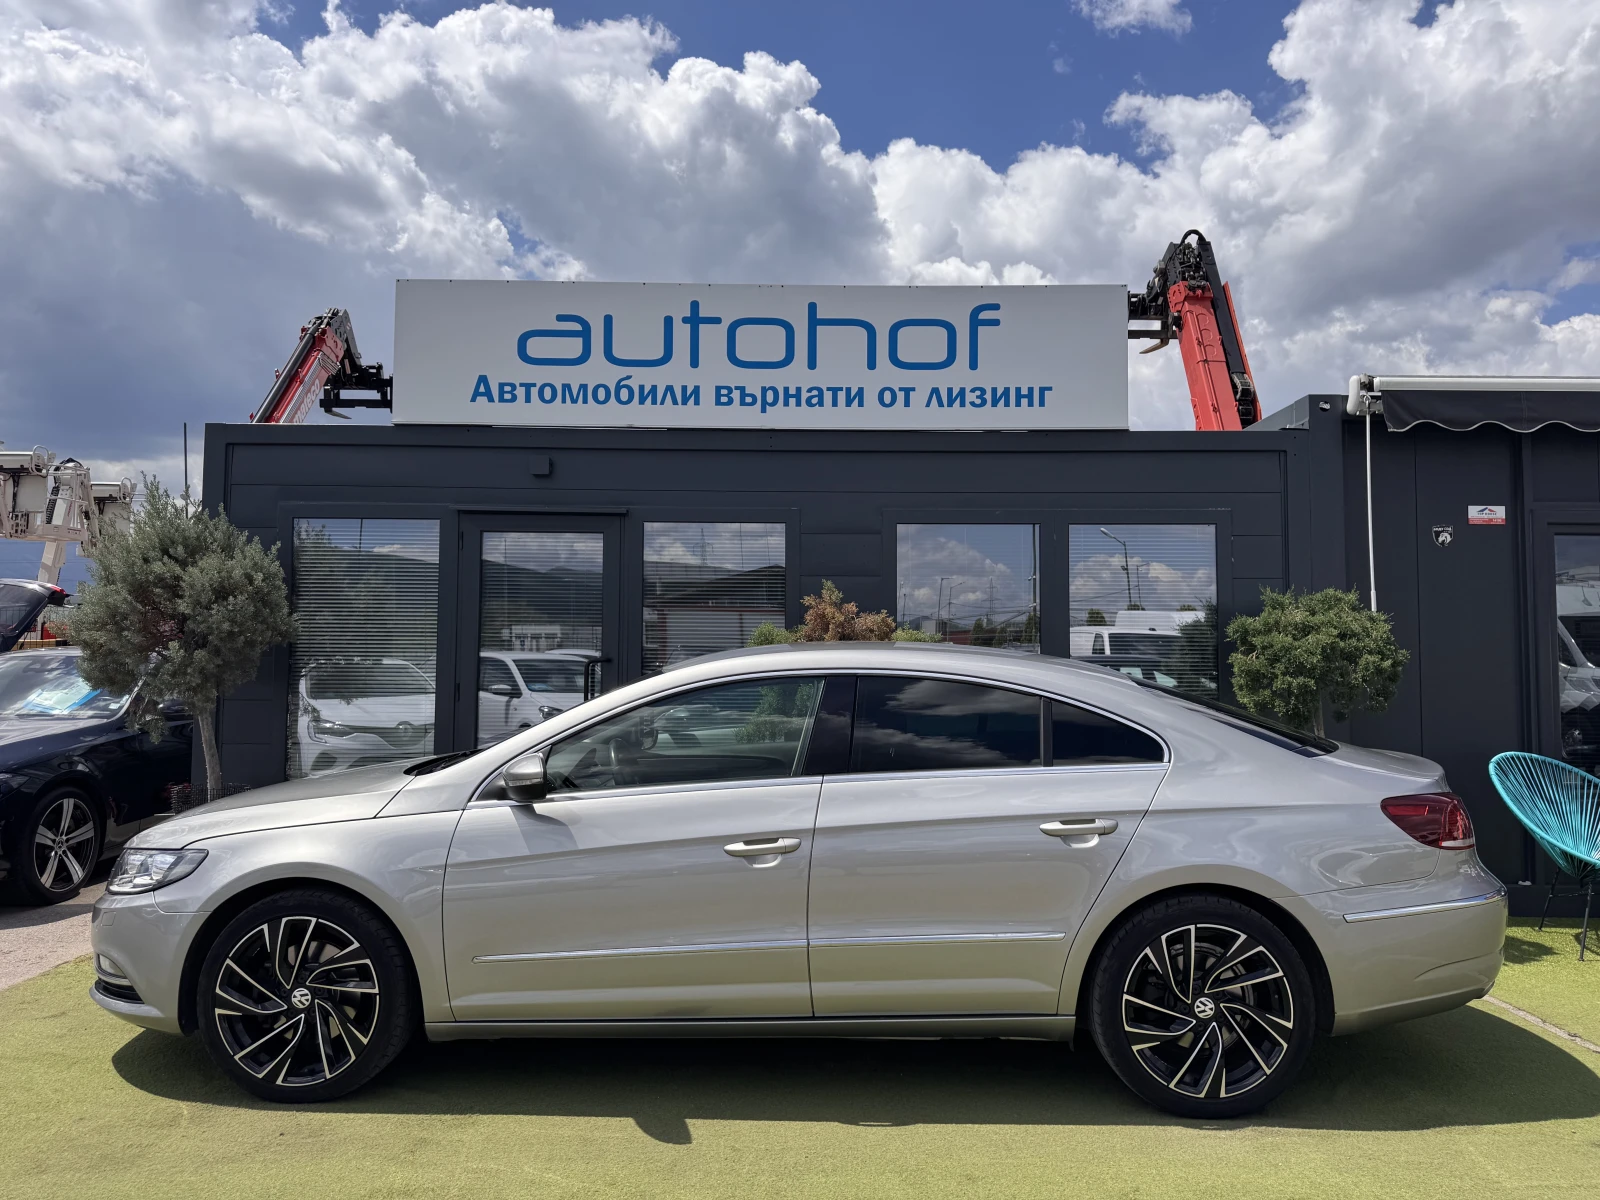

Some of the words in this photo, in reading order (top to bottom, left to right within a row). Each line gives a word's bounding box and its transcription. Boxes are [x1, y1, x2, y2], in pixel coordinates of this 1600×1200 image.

[517, 299, 1001, 371] autohof
[470, 374, 701, 407] Автомобили
[714, 385, 865, 414] върнати
[878, 386, 916, 409] от
[925, 386, 1053, 409] лизинг
